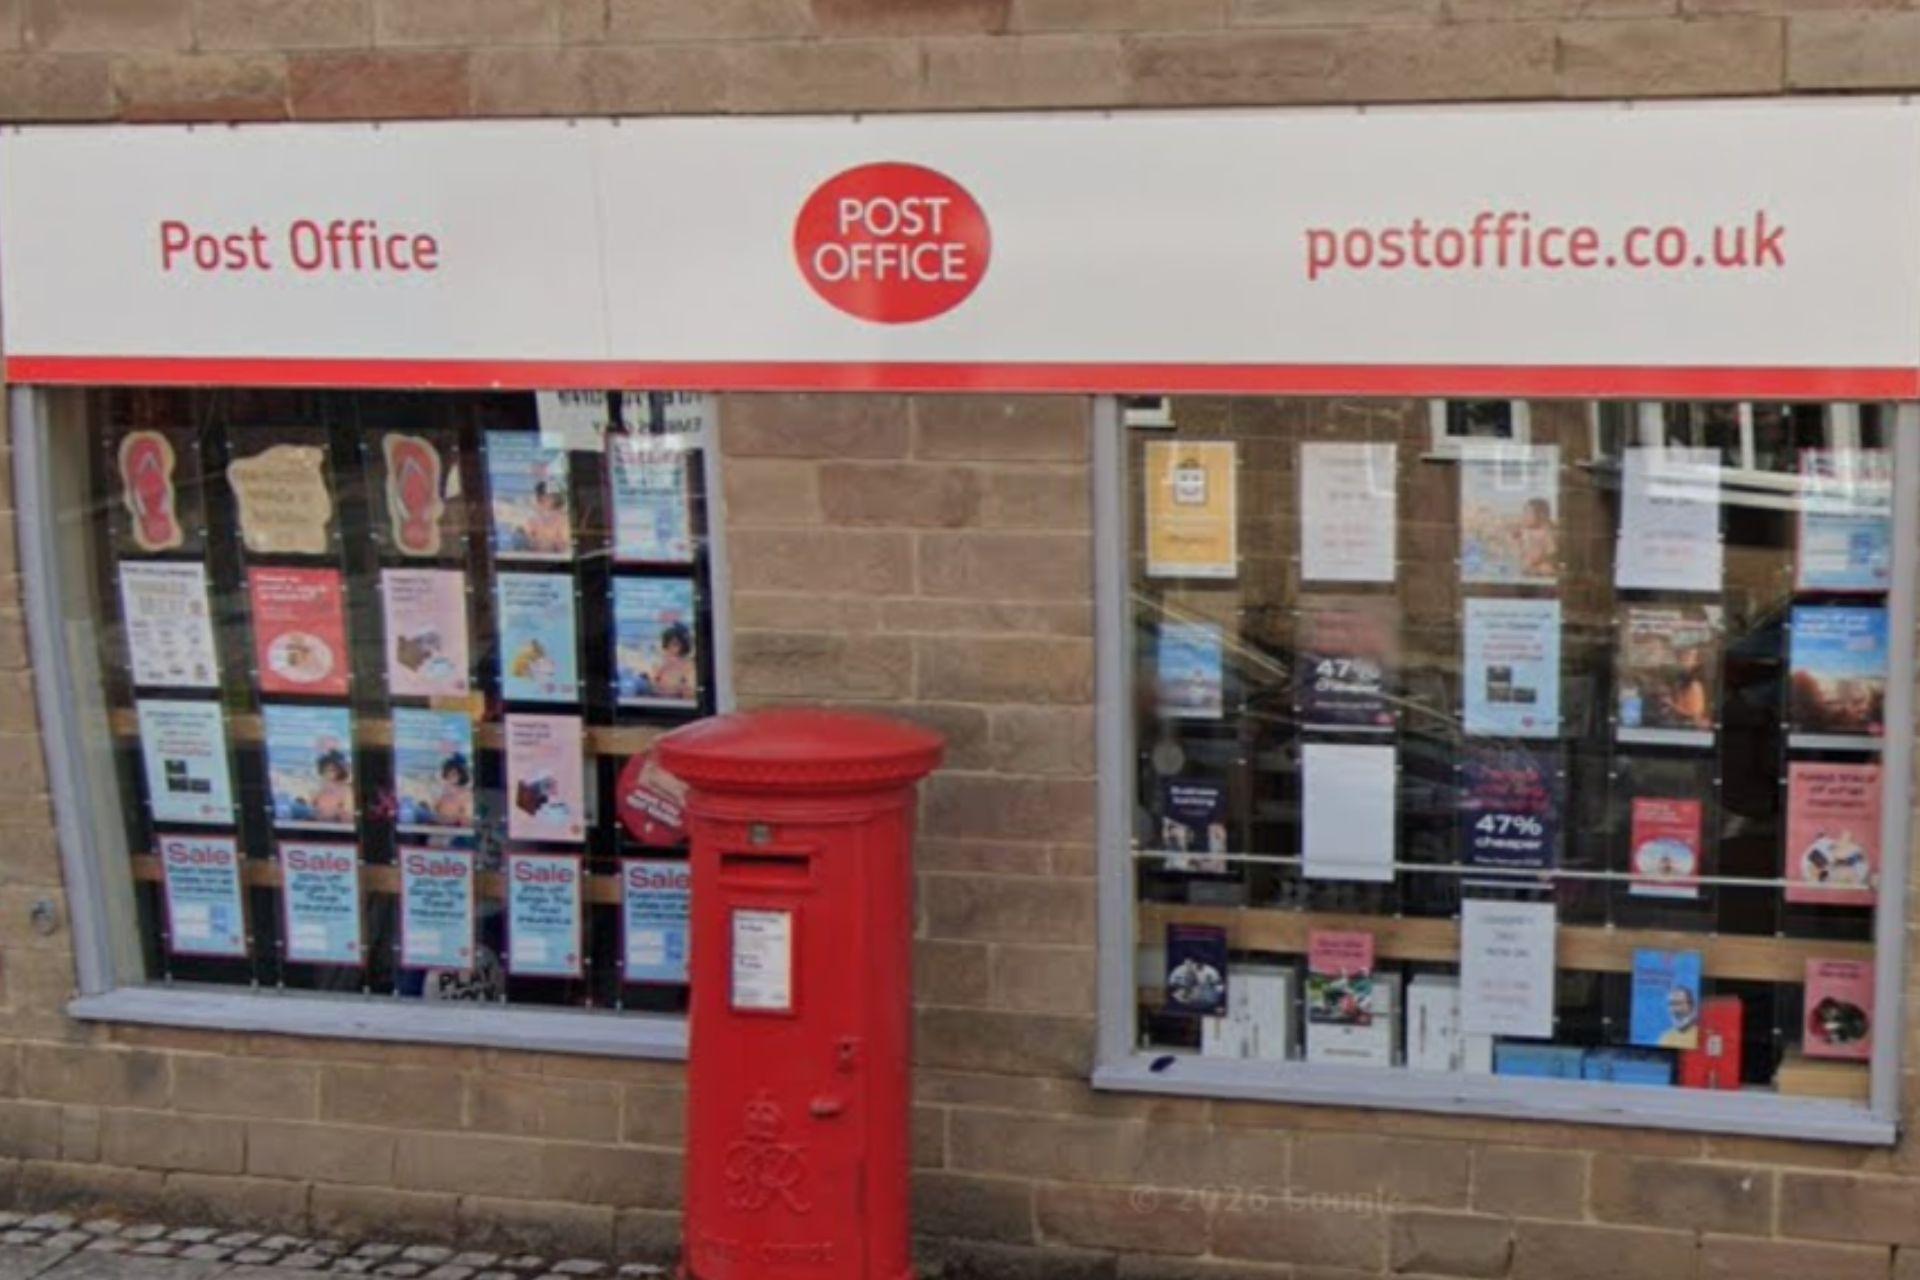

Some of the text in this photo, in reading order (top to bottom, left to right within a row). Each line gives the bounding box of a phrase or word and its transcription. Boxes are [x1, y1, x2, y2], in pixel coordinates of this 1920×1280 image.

[838, 197, 950, 237] POST
[161, 219, 440, 271] Post Office
[1305, 210, 1786, 281] postoffice.co.uk
[813, 242, 968, 282] OFFICE
[1474, 813, 1543, 836] 47%
[167, 843, 231, 865] Sale
[1473, 836, 1543, 850] cheaper
[287, 850, 351, 872] Sale
[406, 855, 468, 877] Sale
[515, 860, 573, 883] Sale
[629, 866, 690, 889] Sale
